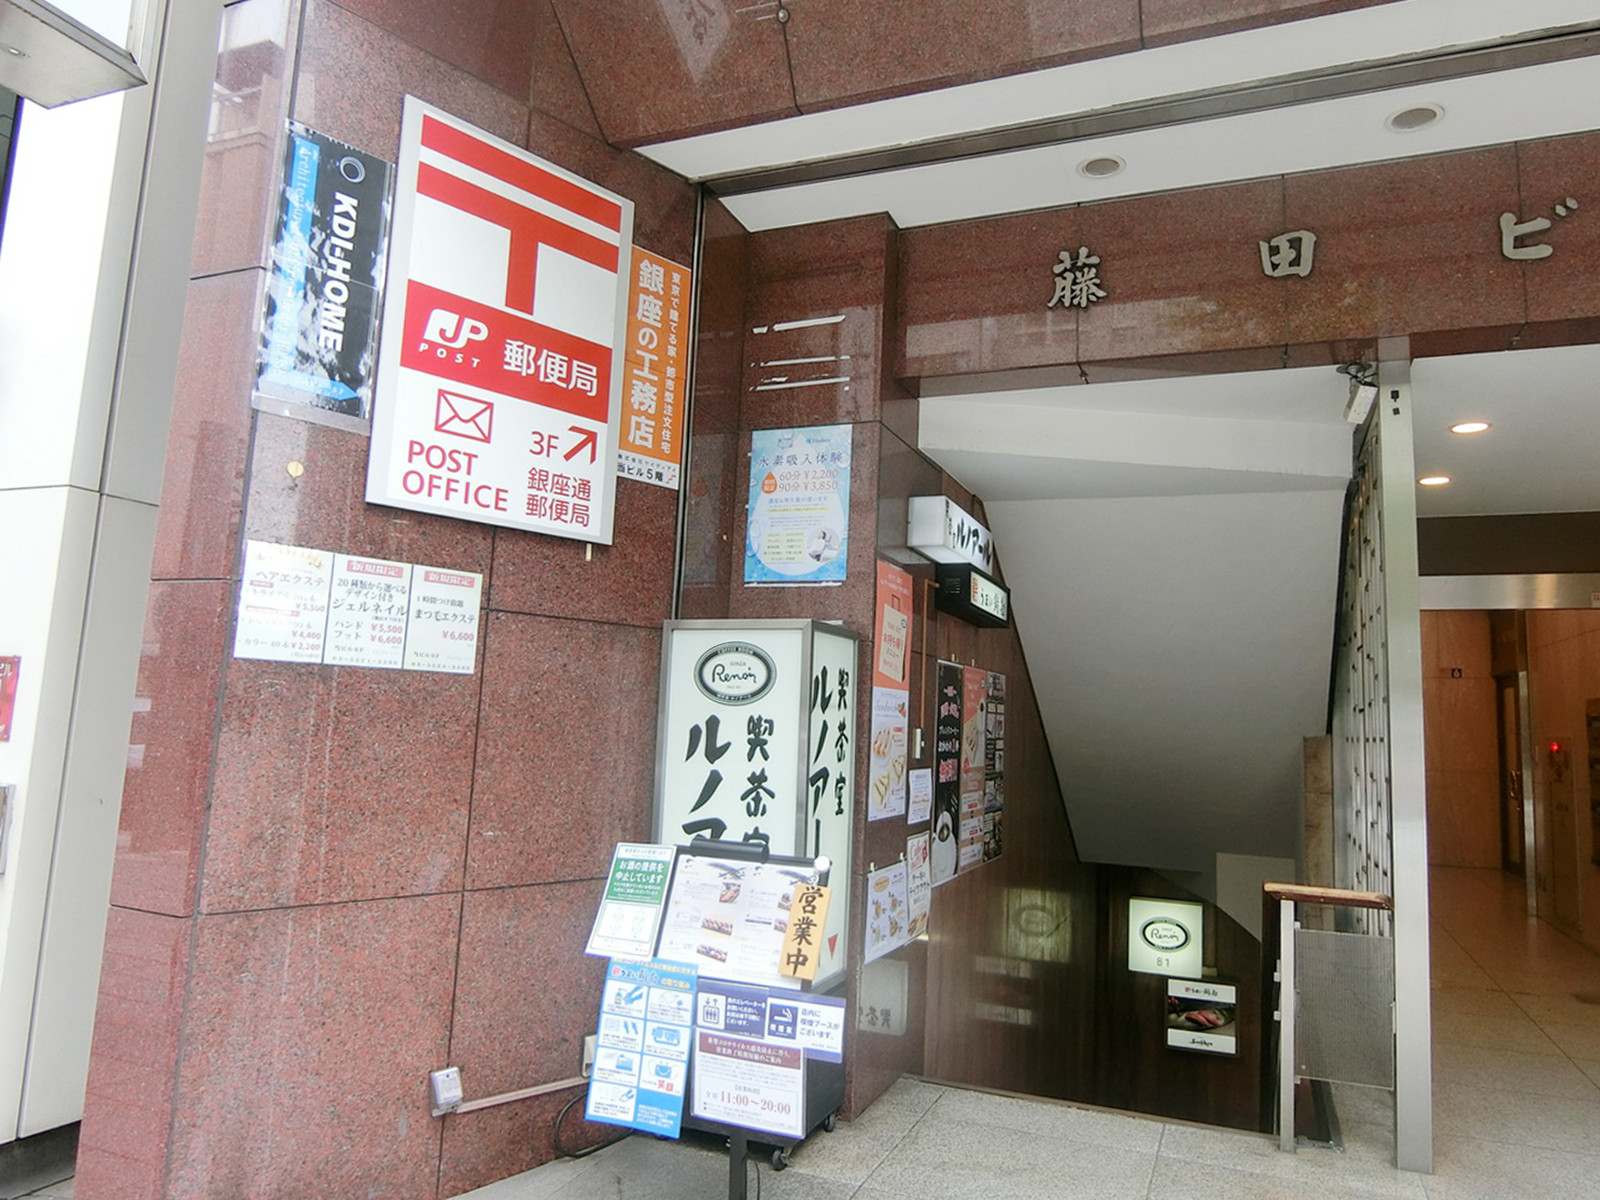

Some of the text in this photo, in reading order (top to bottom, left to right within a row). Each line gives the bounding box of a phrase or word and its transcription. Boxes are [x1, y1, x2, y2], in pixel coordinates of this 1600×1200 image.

[317, 190, 359, 352] KDI-HOME
[418, 342, 480, 369] POST
[628, 258, 664, 450] 銀座の工務店
[502, 338, 598, 398] 郵便局
[528, 430, 559, 458] 3F
[407, 439, 478, 476] POST
[758, 451, 844, 468] 水素吸入体験
[617, 461, 664, 483] 当ビル5階
[402, 469, 509, 512] OFFICE
[527, 467, 592, 502] 銀座通
[525, 493, 591, 528] 郵便局
[256, 570, 325, 588] ヘアエクステ
[345, 588, 395, 603] デザイン付き
[332, 597, 407, 617] ジェルネイル
[414, 608, 476, 625] まつ毛エクステ
[334, 620, 404, 635] ハンド ¥5,500
[441, 629, 475, 642] ¥6,600
[333, 630, 403, 646] フット ¥6,600
[711, 662, 757, 684] Renoir
[834, 666, 850, 816] 喫茶室
[618, 860, 665, 874] お酒の提供を
[614, 871, 665, 884] 中止しています
[785, 885, 824, 977] 営業中
[1150, 927, 1179, 942] Renoir
[1156, 957, 1170, 968] B1
[800, 1007, 821, 1019] 店内に
[799, 1028, 835, 1041] ございます。
[800, 1018, 840, 1032] 喫煙ブースが
